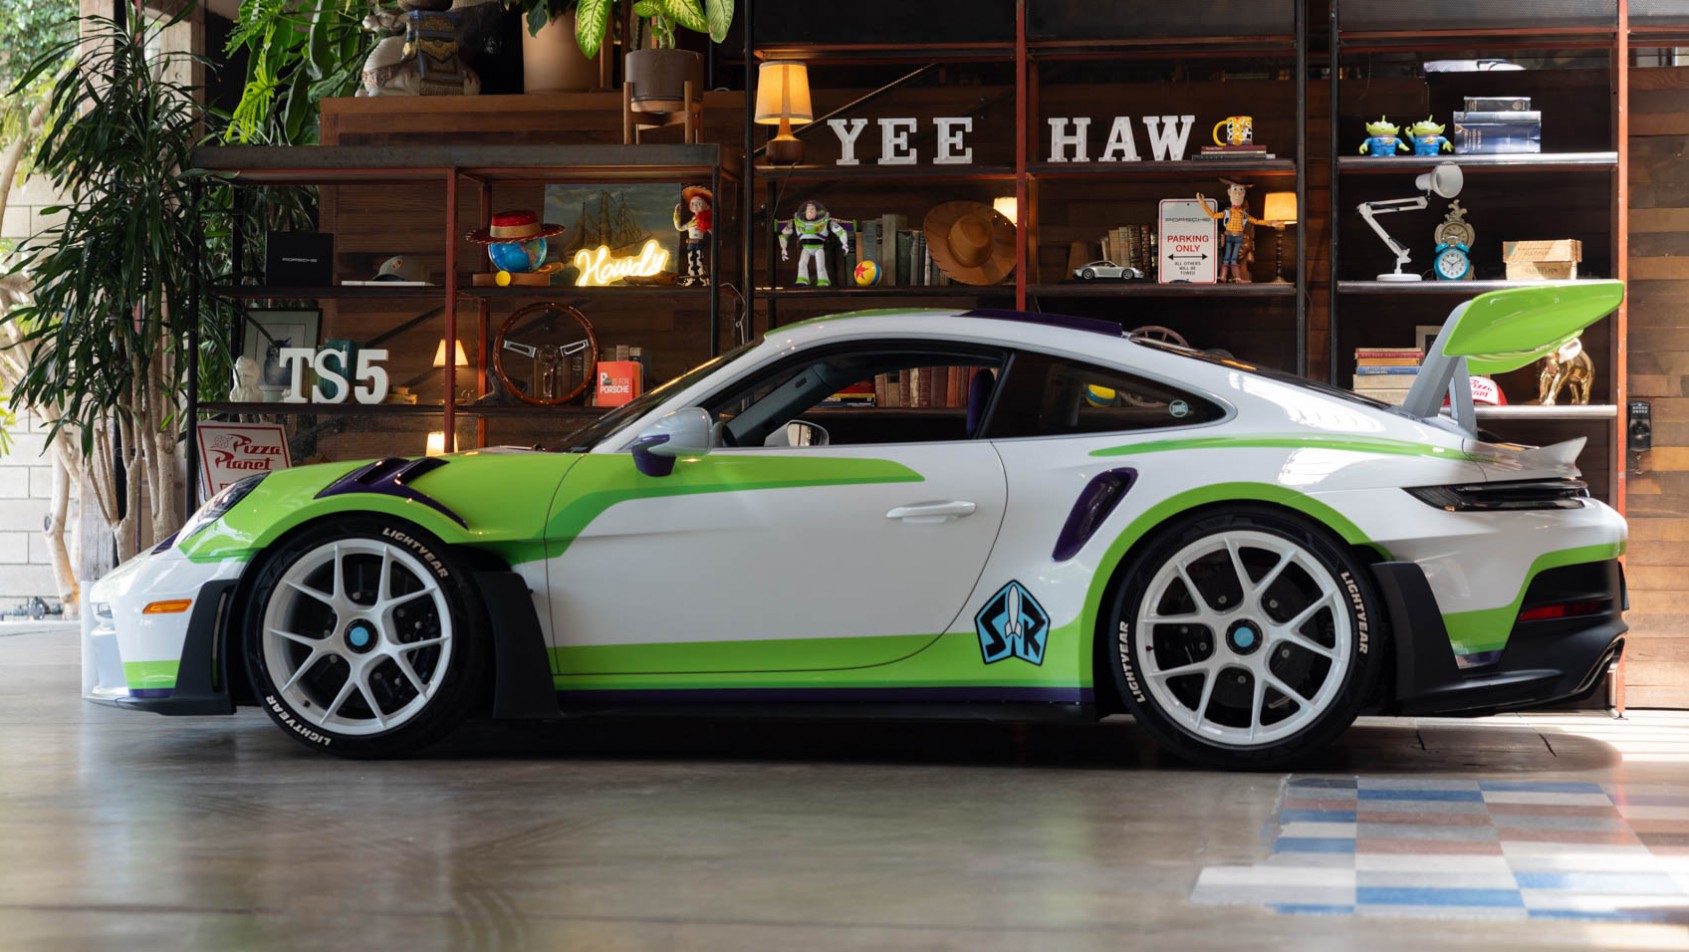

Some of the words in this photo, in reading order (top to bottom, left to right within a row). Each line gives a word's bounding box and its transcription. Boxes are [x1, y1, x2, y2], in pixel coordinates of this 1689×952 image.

[827, 117, 973, 165] YEE
[1048, 115, 1195, 163] HAW
[1167, 235, 1209, 243] PARKING
[1175, 244, 1201, 253] ONLY
[575, 241, 668, 287] Howdy
[279, 348, 389, 404] TS5
[600, 385, 629, 394] PORSCHE
[208, 449, 275, 471] Planet
[226, 433, 282, 455] Pizza
[382, 527, 448, 578] LIGHTYEAR
[1341, 571, 1368, 654] LIGHTYEAR
[1119, 621, 1146, 703] LIGHTYEAR
[265, 694, 331, 746] LIGHTYEAR
